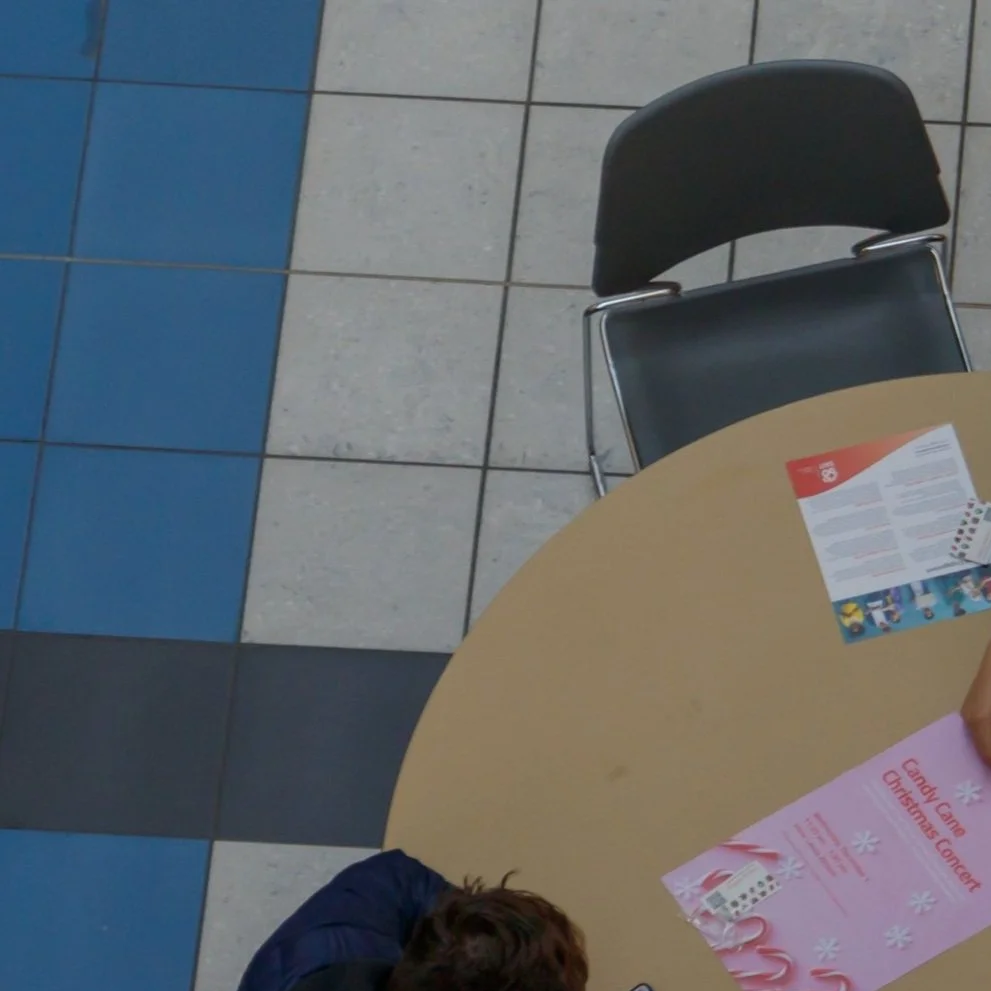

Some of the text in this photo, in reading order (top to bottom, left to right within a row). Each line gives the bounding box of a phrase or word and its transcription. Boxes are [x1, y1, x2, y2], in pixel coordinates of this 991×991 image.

[882, 769, 940, 840] Christmas
[935, 838, 982, 893] Concert
[901, 758, 967, 838] Candy Cane
